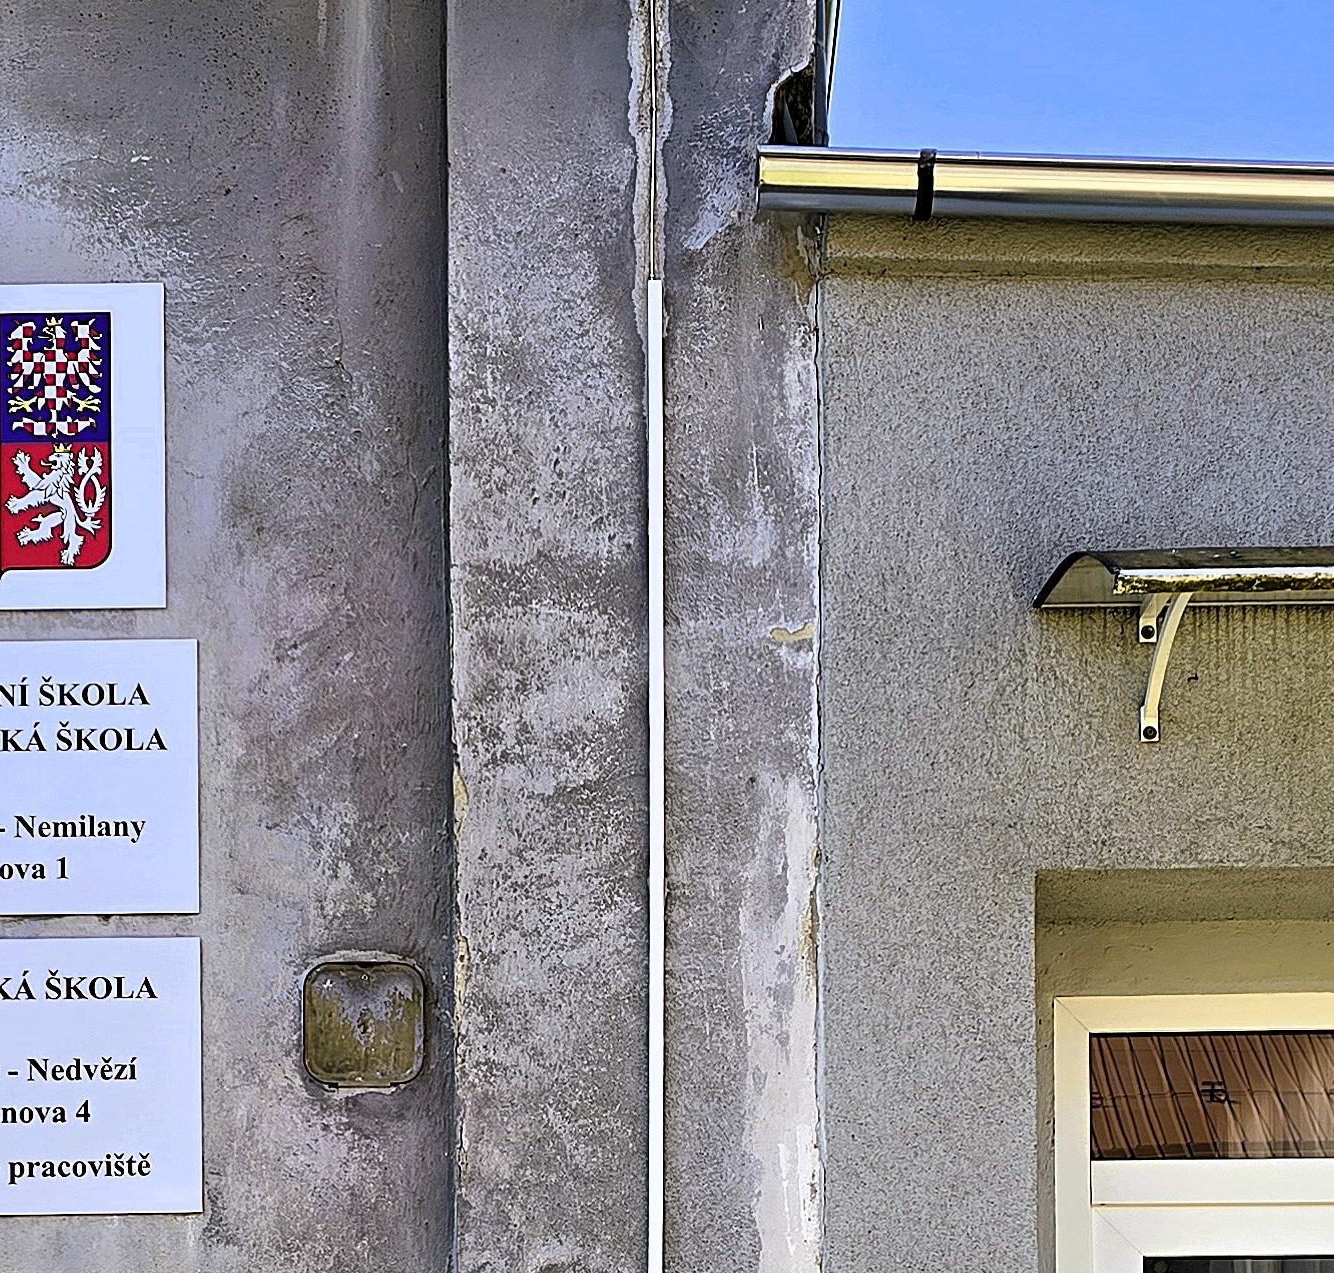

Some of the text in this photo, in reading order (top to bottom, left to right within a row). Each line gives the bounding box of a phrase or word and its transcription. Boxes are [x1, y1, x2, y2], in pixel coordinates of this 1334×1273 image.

[39, 676, 150, 706] ŠKOLA
[57, 721, 167, 751] ŠKOLA
[14, 815, 146, 843] Nemilany
[57, 857, 68, 879] 1
[46, 970, 158, 999] ŠKOLA
[27, 1057, 137, 1081] Nedvězí
[76, 1100, 90, 1122] 4
[9, 1153, 150, 1184] pracoviště
